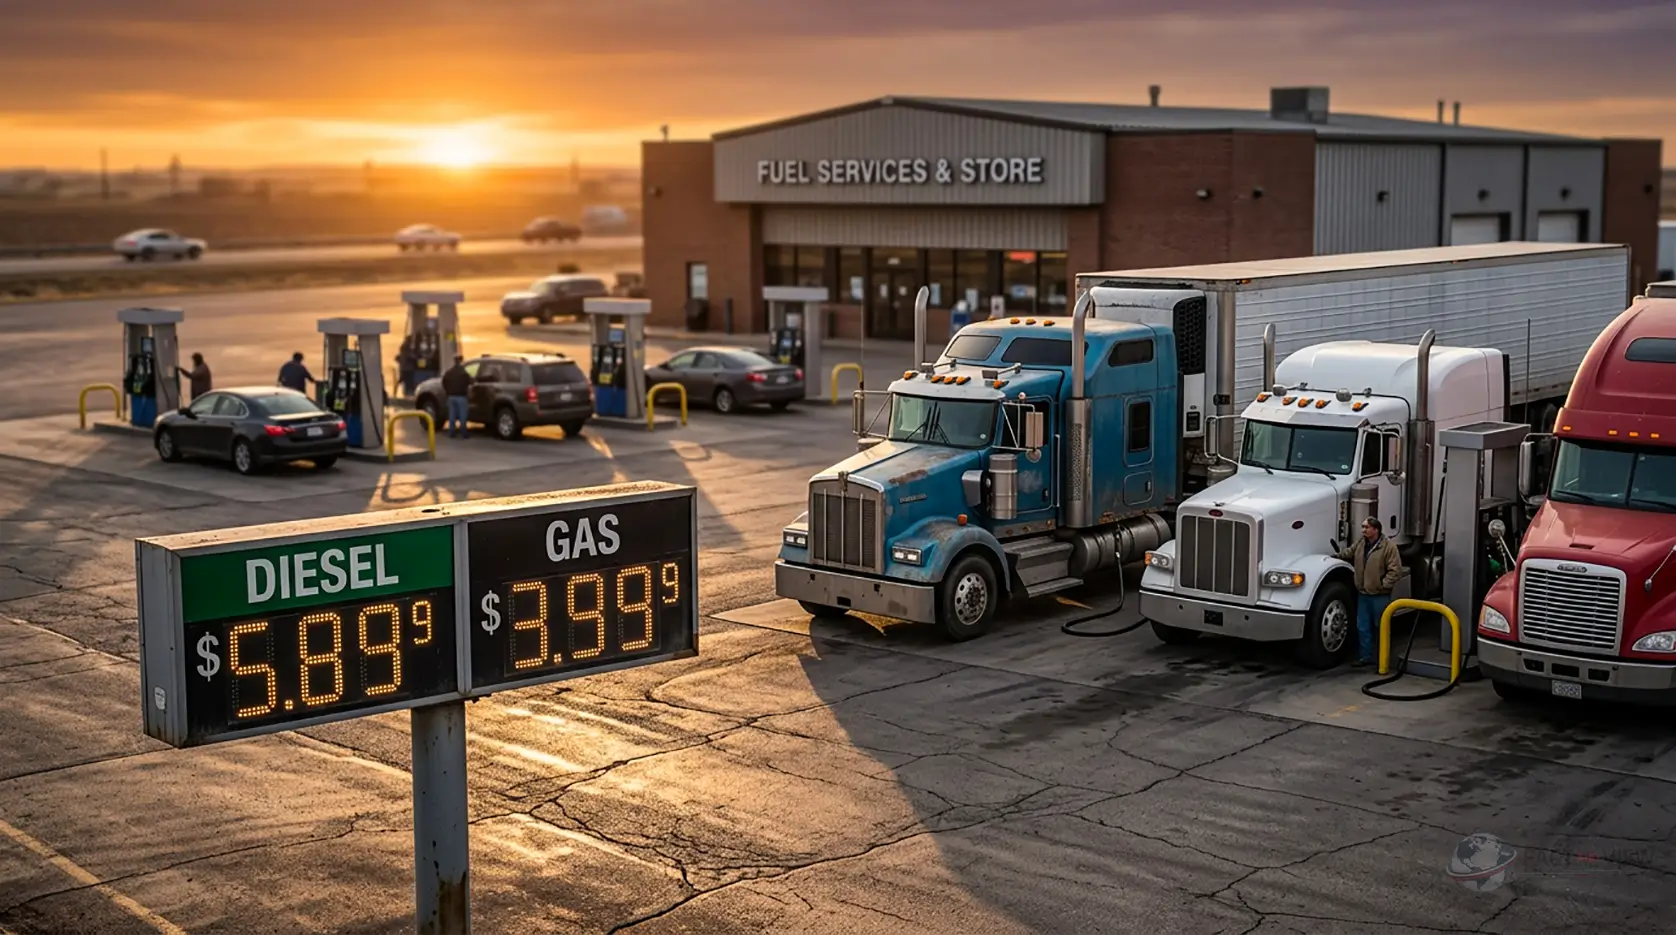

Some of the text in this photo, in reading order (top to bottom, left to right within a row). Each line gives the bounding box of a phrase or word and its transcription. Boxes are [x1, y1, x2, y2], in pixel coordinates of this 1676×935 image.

[757, 157, 1042, 184] FUEL SERVICES & STORE
[545, 513, 620, 562] GAS
[246, 543, 399, 604] DIESEL
